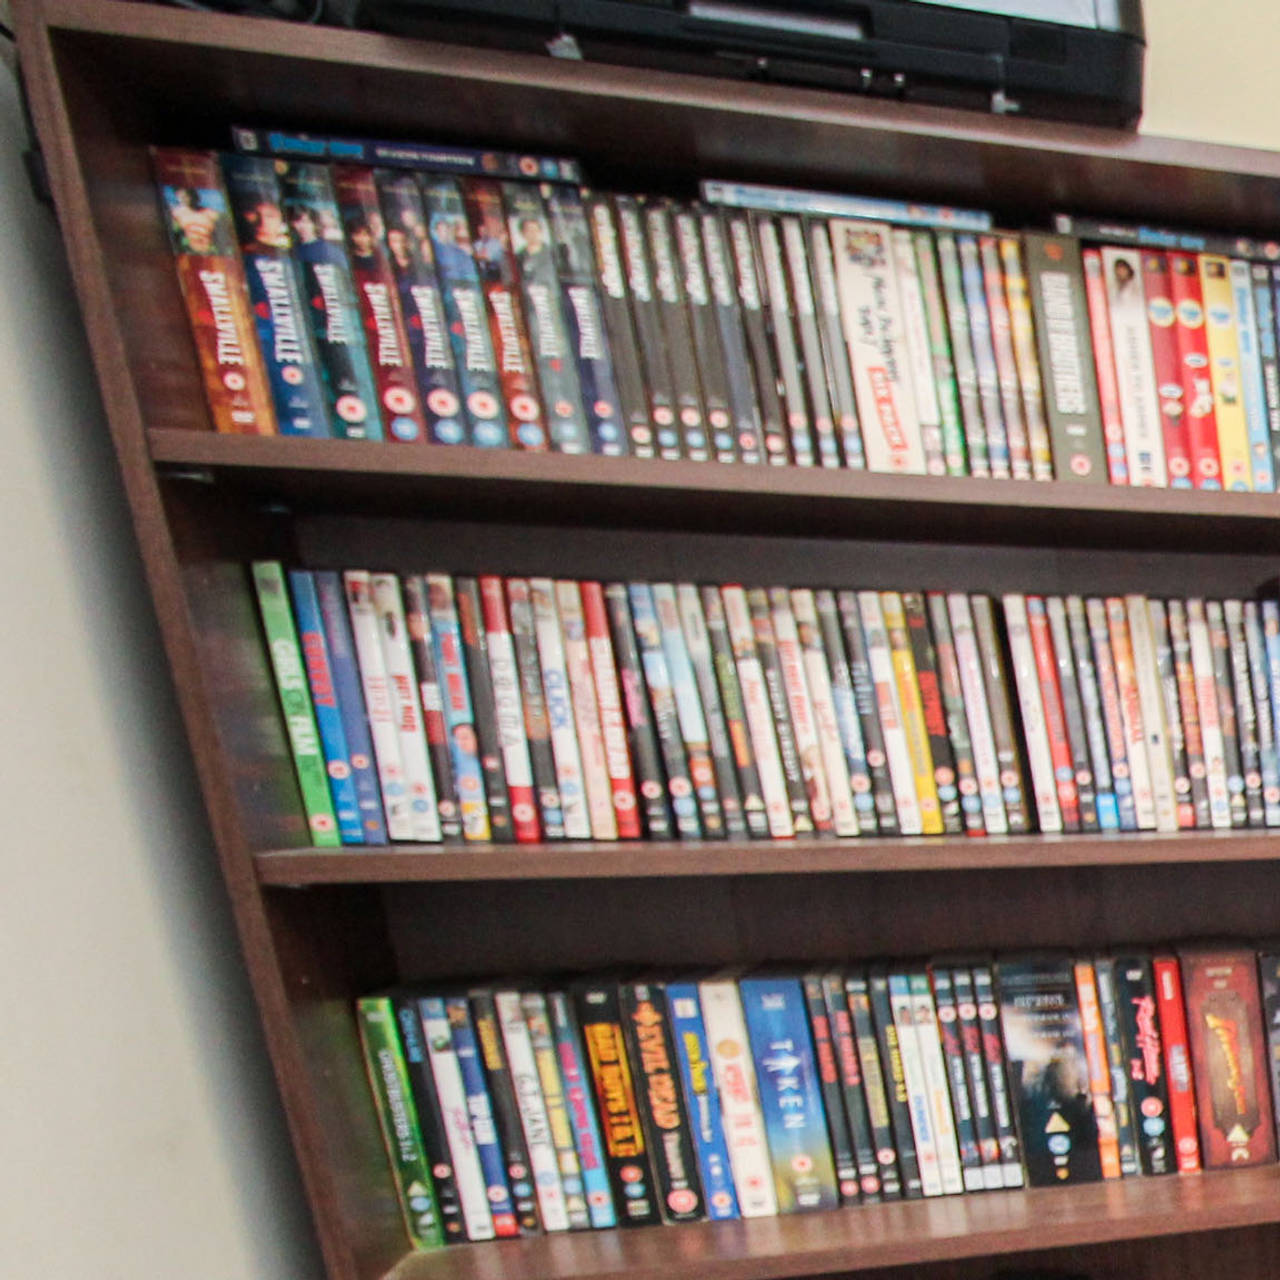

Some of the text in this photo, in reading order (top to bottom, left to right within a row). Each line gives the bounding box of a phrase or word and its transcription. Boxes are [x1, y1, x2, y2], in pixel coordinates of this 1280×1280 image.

[199, 270, 245, 366] SMALLVILLE
[256, 258, 302, 364] SMALLVILLE
[314, 262, 347, 344] SMALLVILLE
[363, 282, 403, 367] SMALLVILLE
[411, 284, 448, 370] SMALLVILLE
[452, 287, 489, 371] SMALLVILLE
[490, 290, 526, 374] SMALLVILLE
[568, 286, 600, 360] SMALLVILLE
[1050, 333, 1087, 414] BROTHERS
[272, 638, 303, 689] GIRLS
[289, 715, 318, 756] FILM
[302, 632, 336, 708] CONVOY
[543, 668, 570, 730] CLICK
[777, 721, 800, 783] CIRCUIT
[378, 1050, 411, 1140] GHOSTBUSTERS
[637, 1024, 681, 1129] EVIL DEAD
[763, 1039, 806, 1129] TAKEN
